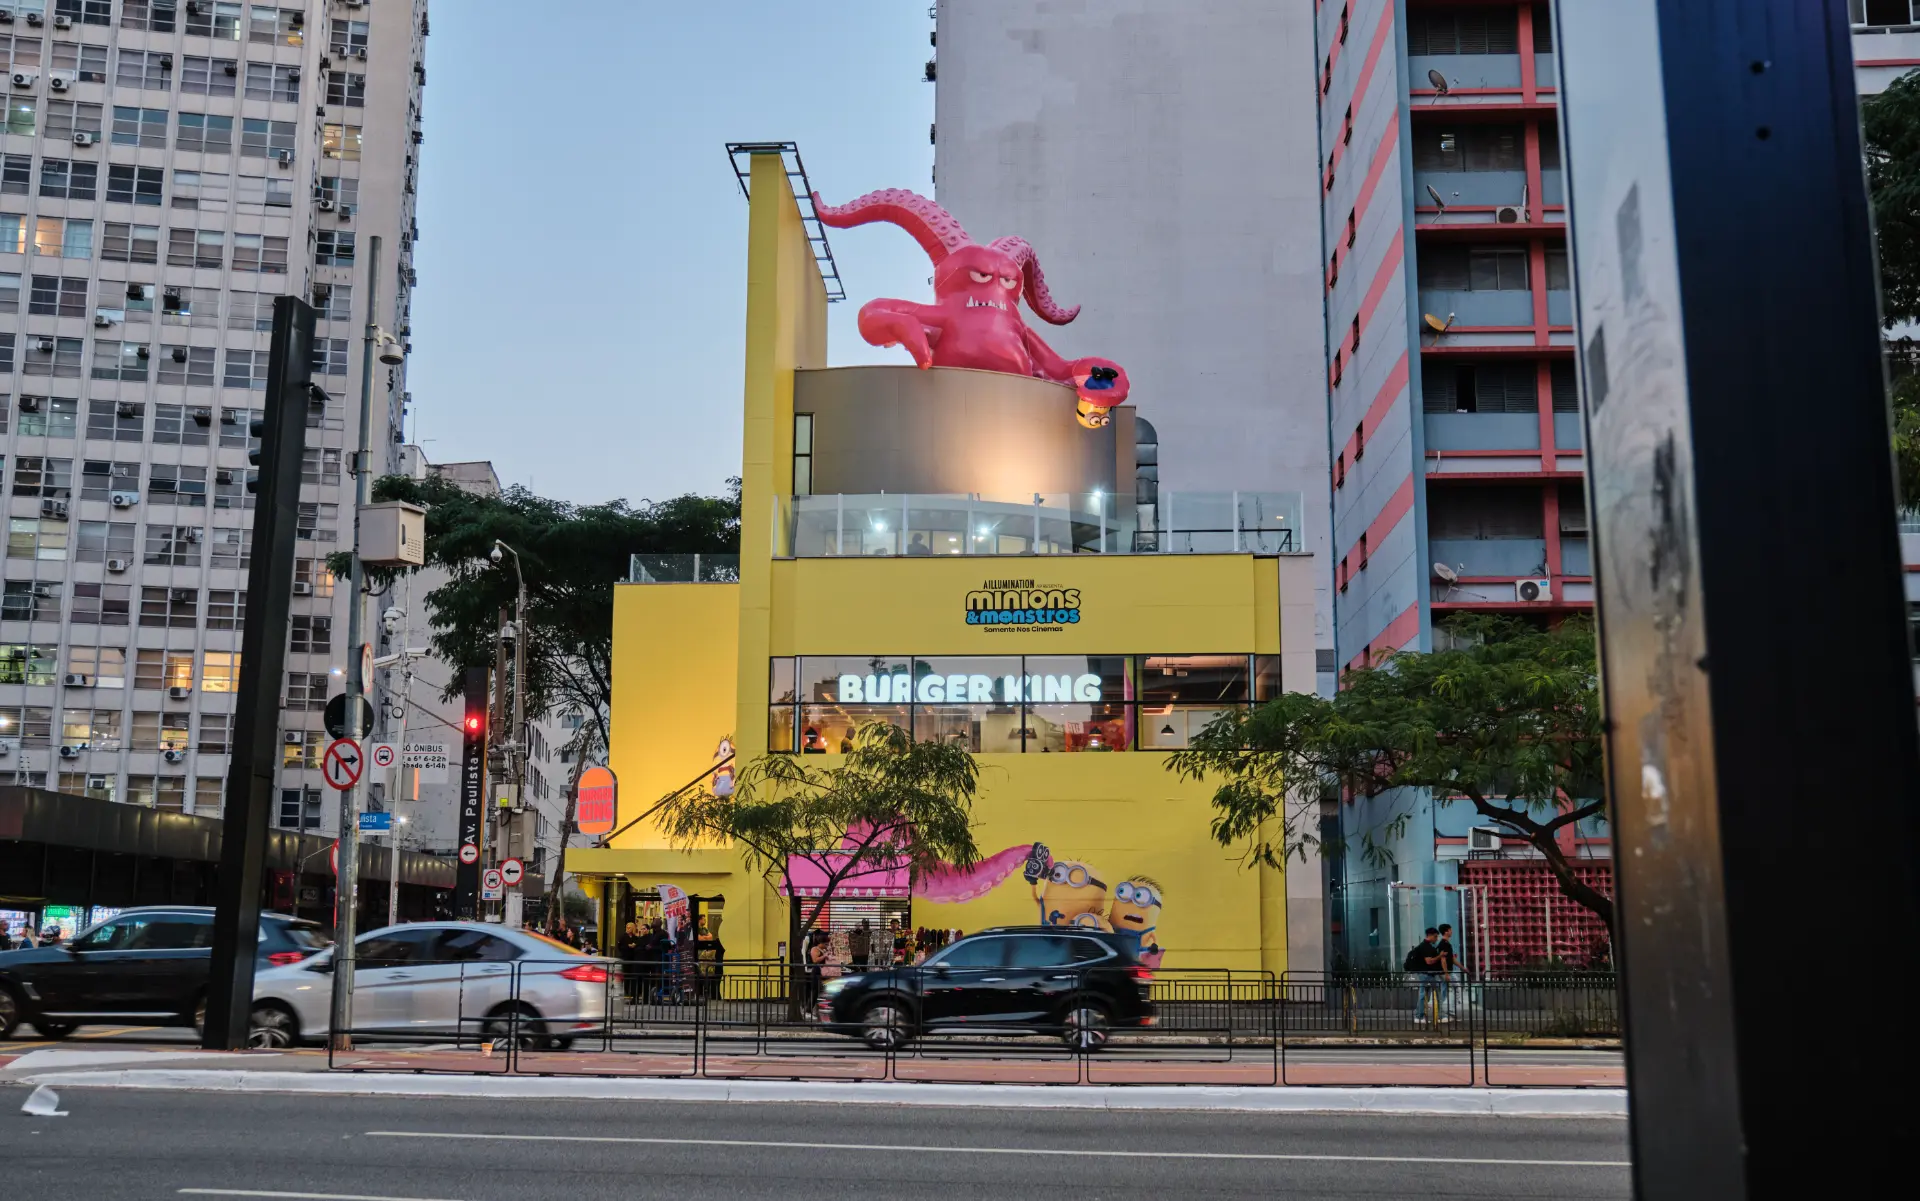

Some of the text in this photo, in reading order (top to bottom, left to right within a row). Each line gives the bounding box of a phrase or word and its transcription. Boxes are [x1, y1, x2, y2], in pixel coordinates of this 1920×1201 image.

[983, 626, 1016, 634] Somente
[1031, 625, 1064, 633] Cinemas
[839, 673, 1102, 703] BURGER KING
[414, 743, 443, 753] ÔNIBUS
[402, 761, 423, 769] ábado
[464, 757, 479, 845] Av. Paulista
[578, 801, 613, 821] KING
